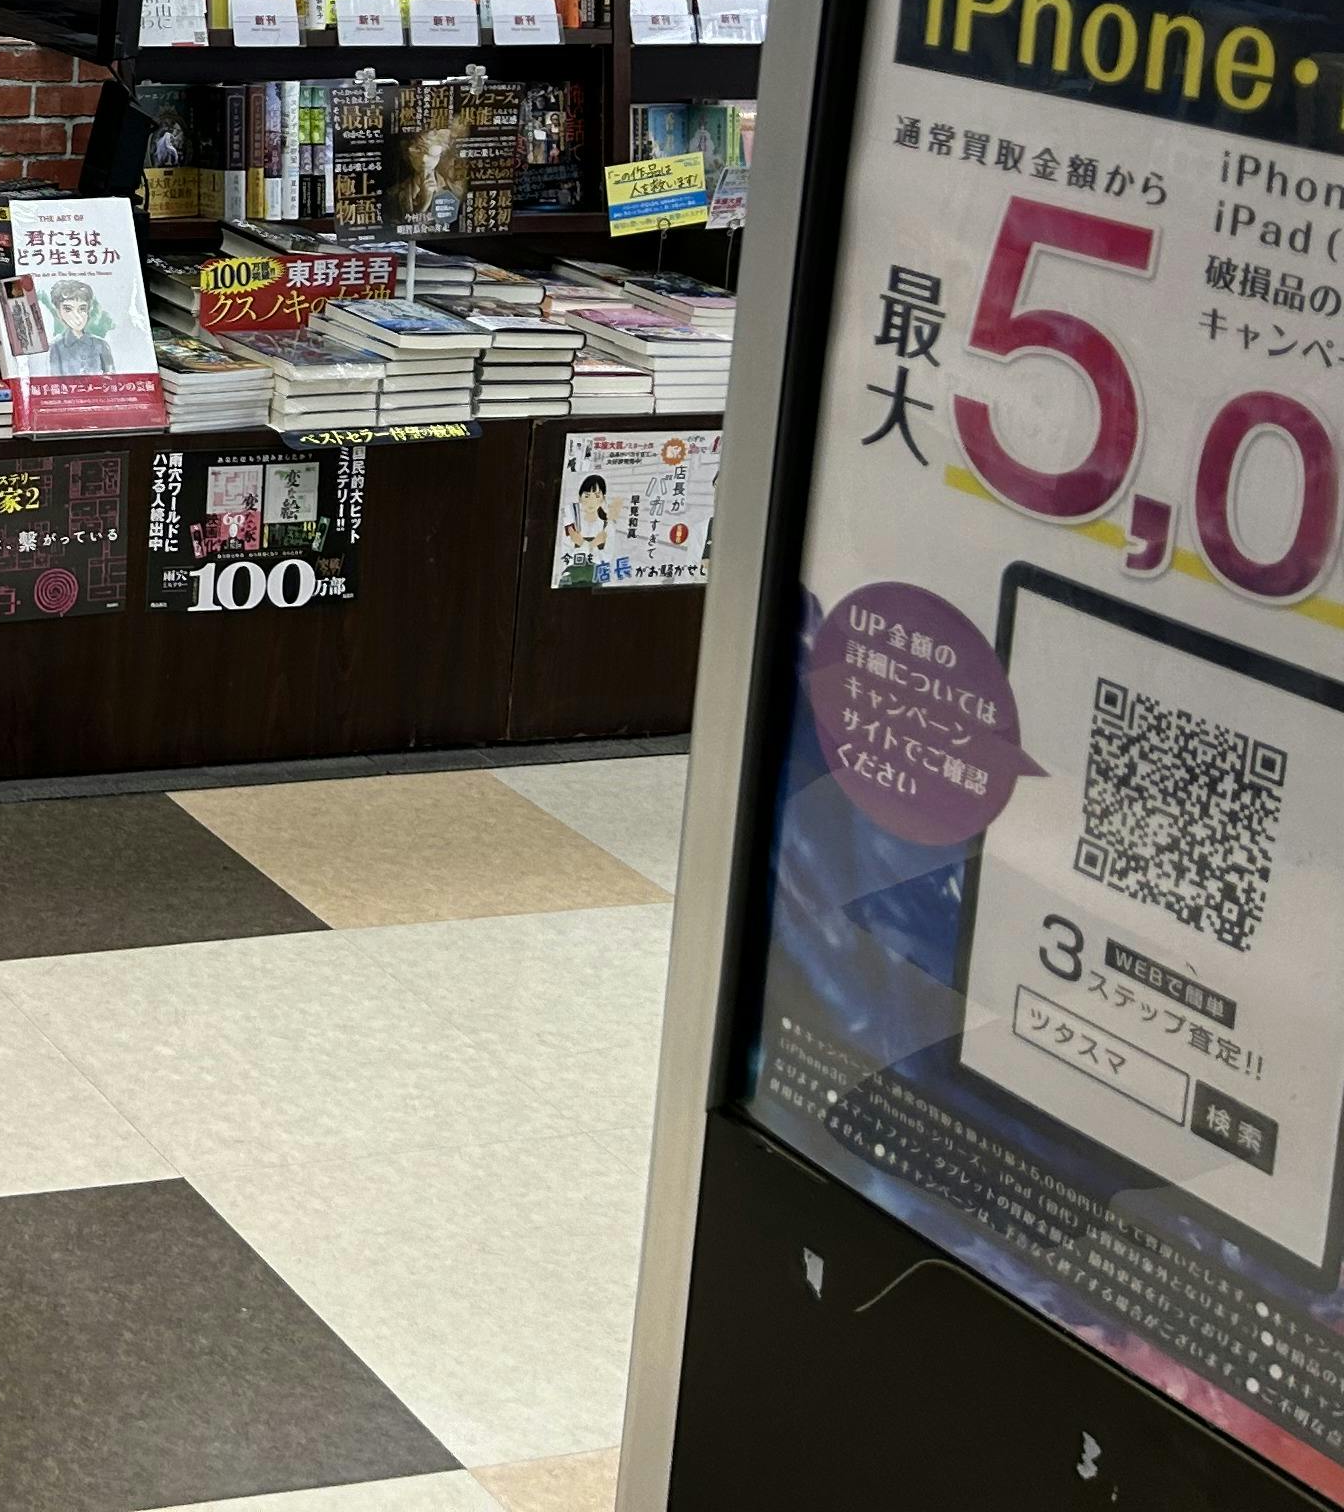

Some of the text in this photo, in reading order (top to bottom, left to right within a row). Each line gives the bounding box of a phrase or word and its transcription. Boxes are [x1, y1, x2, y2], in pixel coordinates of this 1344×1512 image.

[255, 15, 276, 26] 新刊
[359, 15, 380, 26] 新刊
[433, 15, 455, 26] 新刊
[514, 15, 536, 26] 新刊
[893, 115, 1168, 206] 通常買取金額から
[25, 231, 103, 248] 君たちは
[38, 214, 85, 223] THE ART OF
[17, 247, 121, 266] どう生きるか
[210, 261, 252, 290] 100
[286, 256, 393, 288] 東野圭吾
[1204, 253, 1342, 319] 破損品の
[860, 264, 948, 468] 最大
[1198, 306, 1344, 370] キャンペ
[165, 452, 184, 553] 雨穴ワールドに
[336, 448, 349, 532] ミステリー!!
[349, 446, 366, 544] 国民的大ヒット
[671, 465, 688, 512] 店長が
[187, 558, 346, 612] 100 万部
[593, 556, 632, 583] 店長
[848, 605, 957, 669] UP金額の
[844, 676, 972, 745] キャンペーン
[846, 640, 999, 725] 詳細については
[836, 744, 917, 795] ください
[842, 709, 989, 796] サイトでご確認
[1039, 913, 1084, 982] 3
[1115, 948, 1225, 1018] WEBで簡単
[1028, 1008, 1127, 1075] ツタスマ
[1087, 970, 1264, 1081] ステップ査定!!
[1206, 1104, 1264, 1154] 検索
